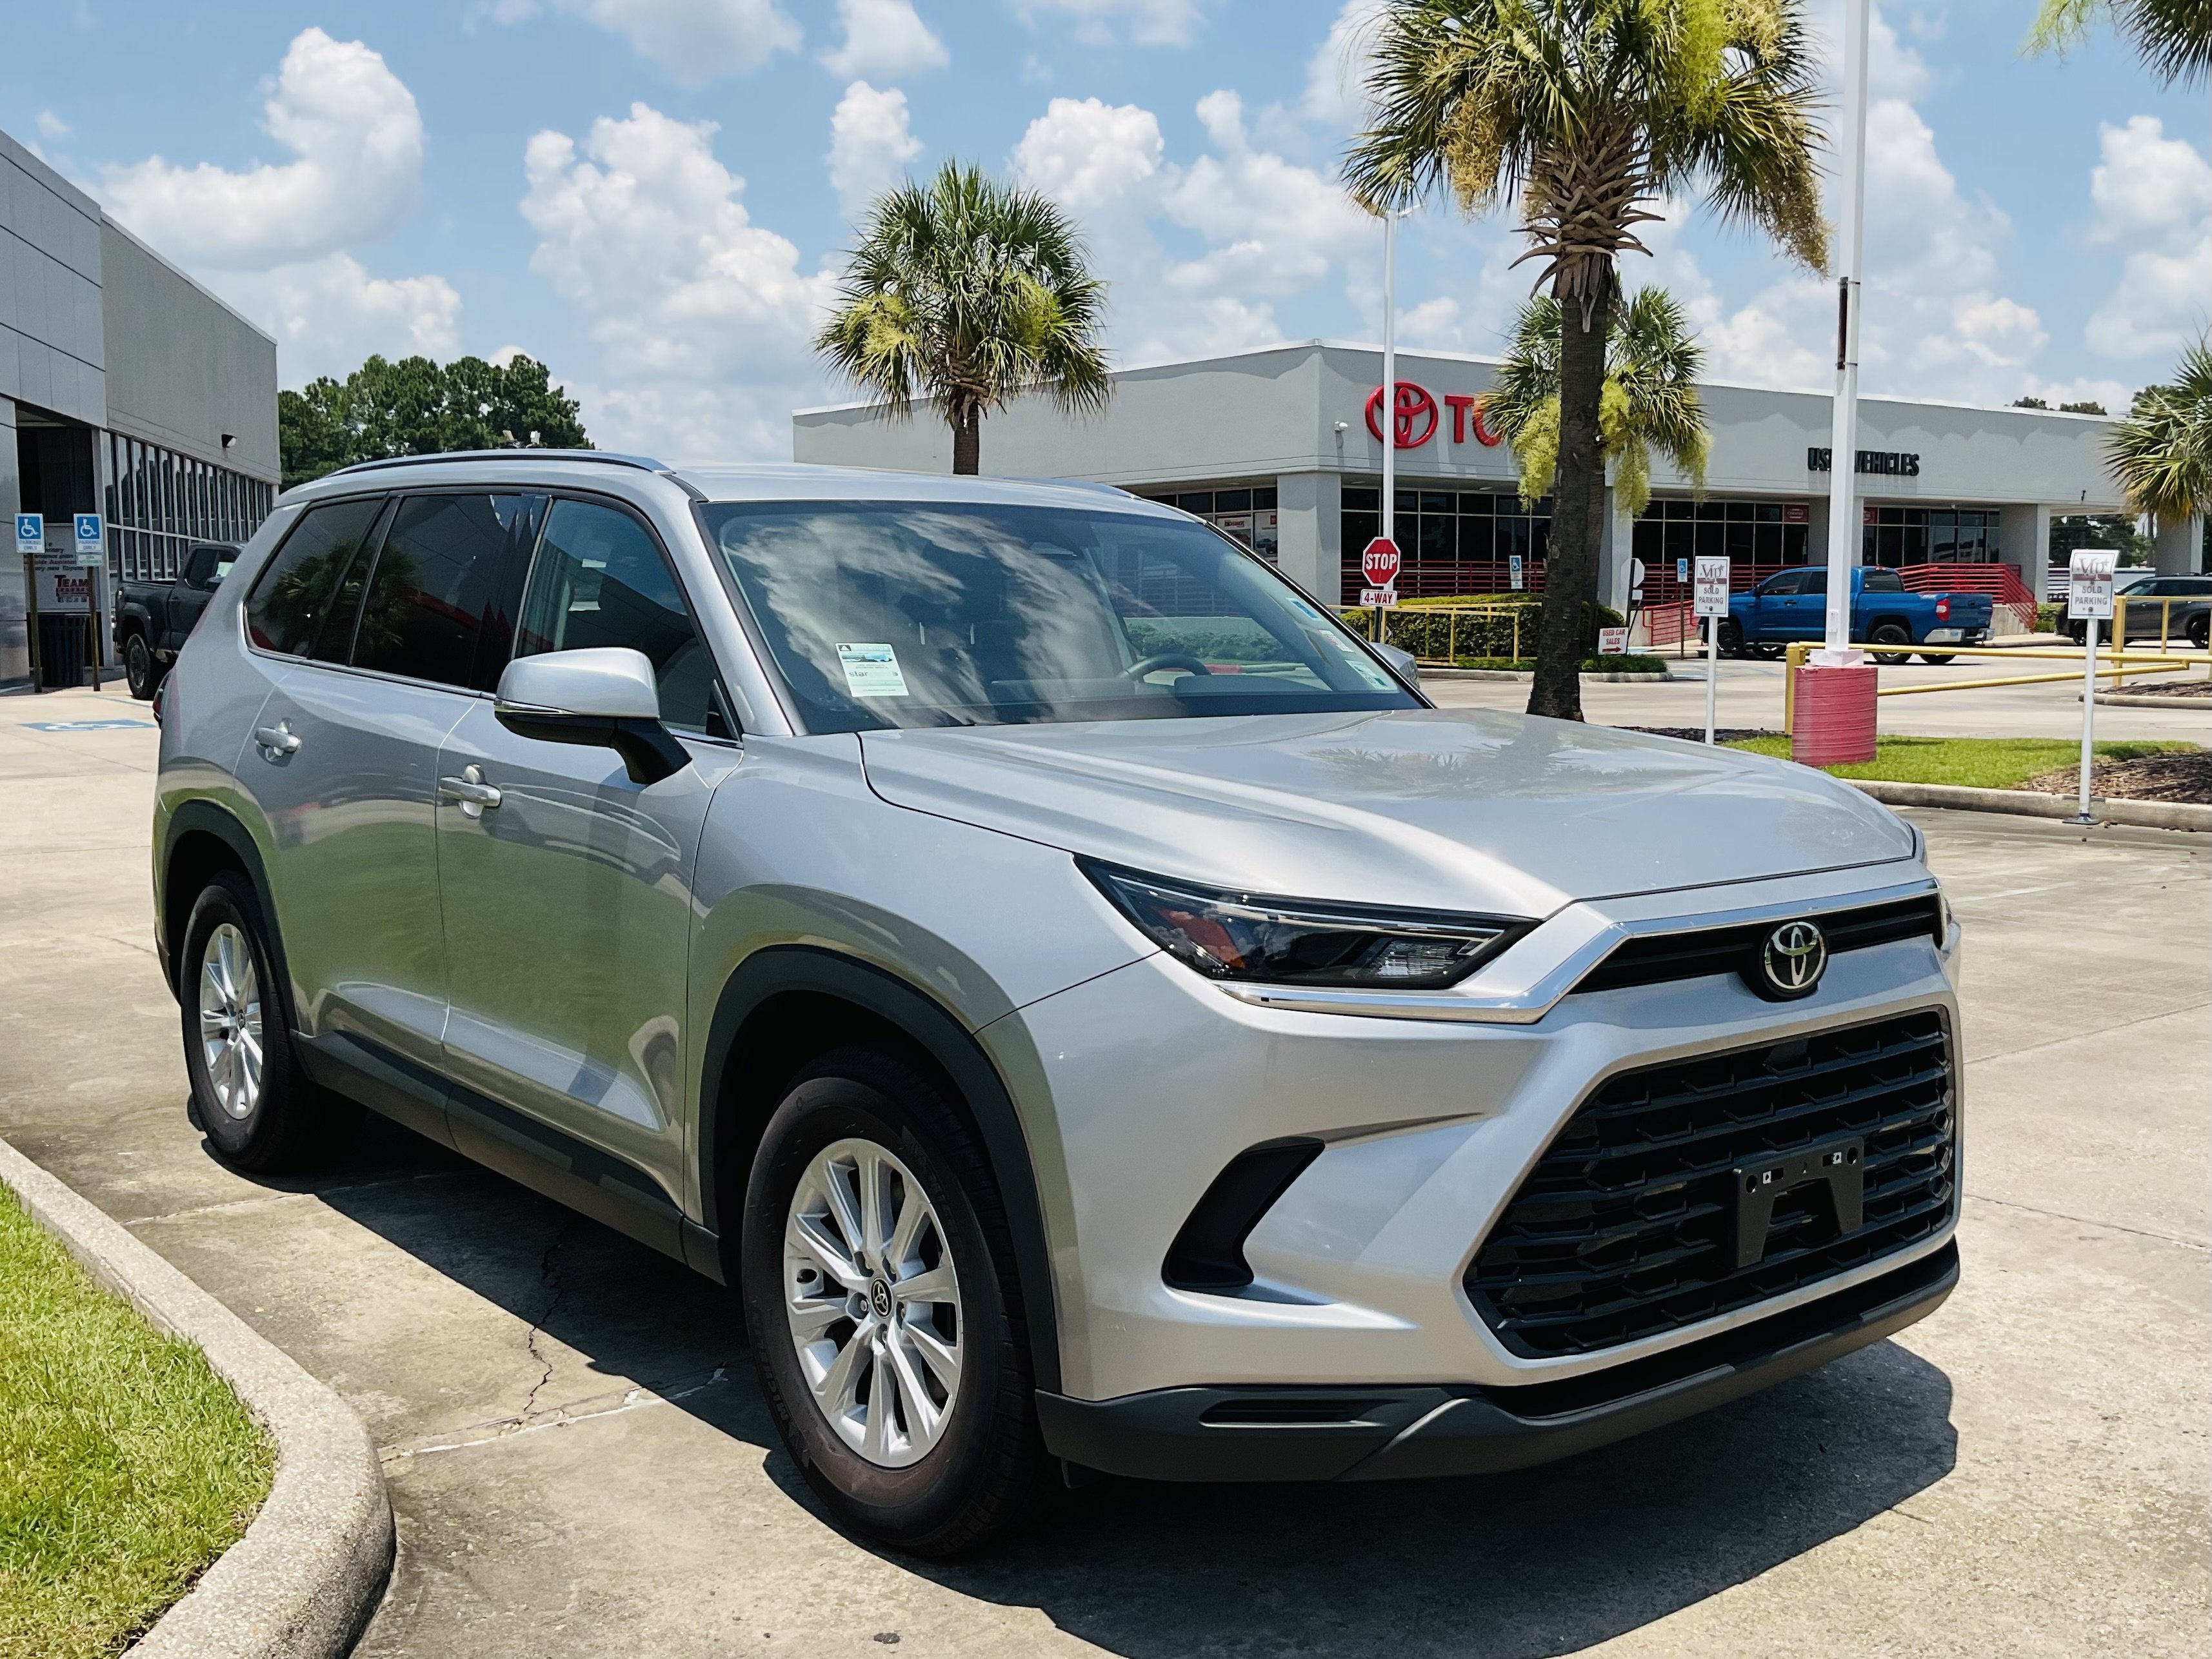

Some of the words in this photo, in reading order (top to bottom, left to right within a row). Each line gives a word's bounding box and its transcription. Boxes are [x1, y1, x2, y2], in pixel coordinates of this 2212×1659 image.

[1808, 448, 1831, 471] US
[1855, 450, 1920, 476] VEHICLES
[1365, 553, 1397, 570] STOP
[1364, 593, 1393, 604] 4-WAY
[2075, 597, 2107, 605] PARKING
